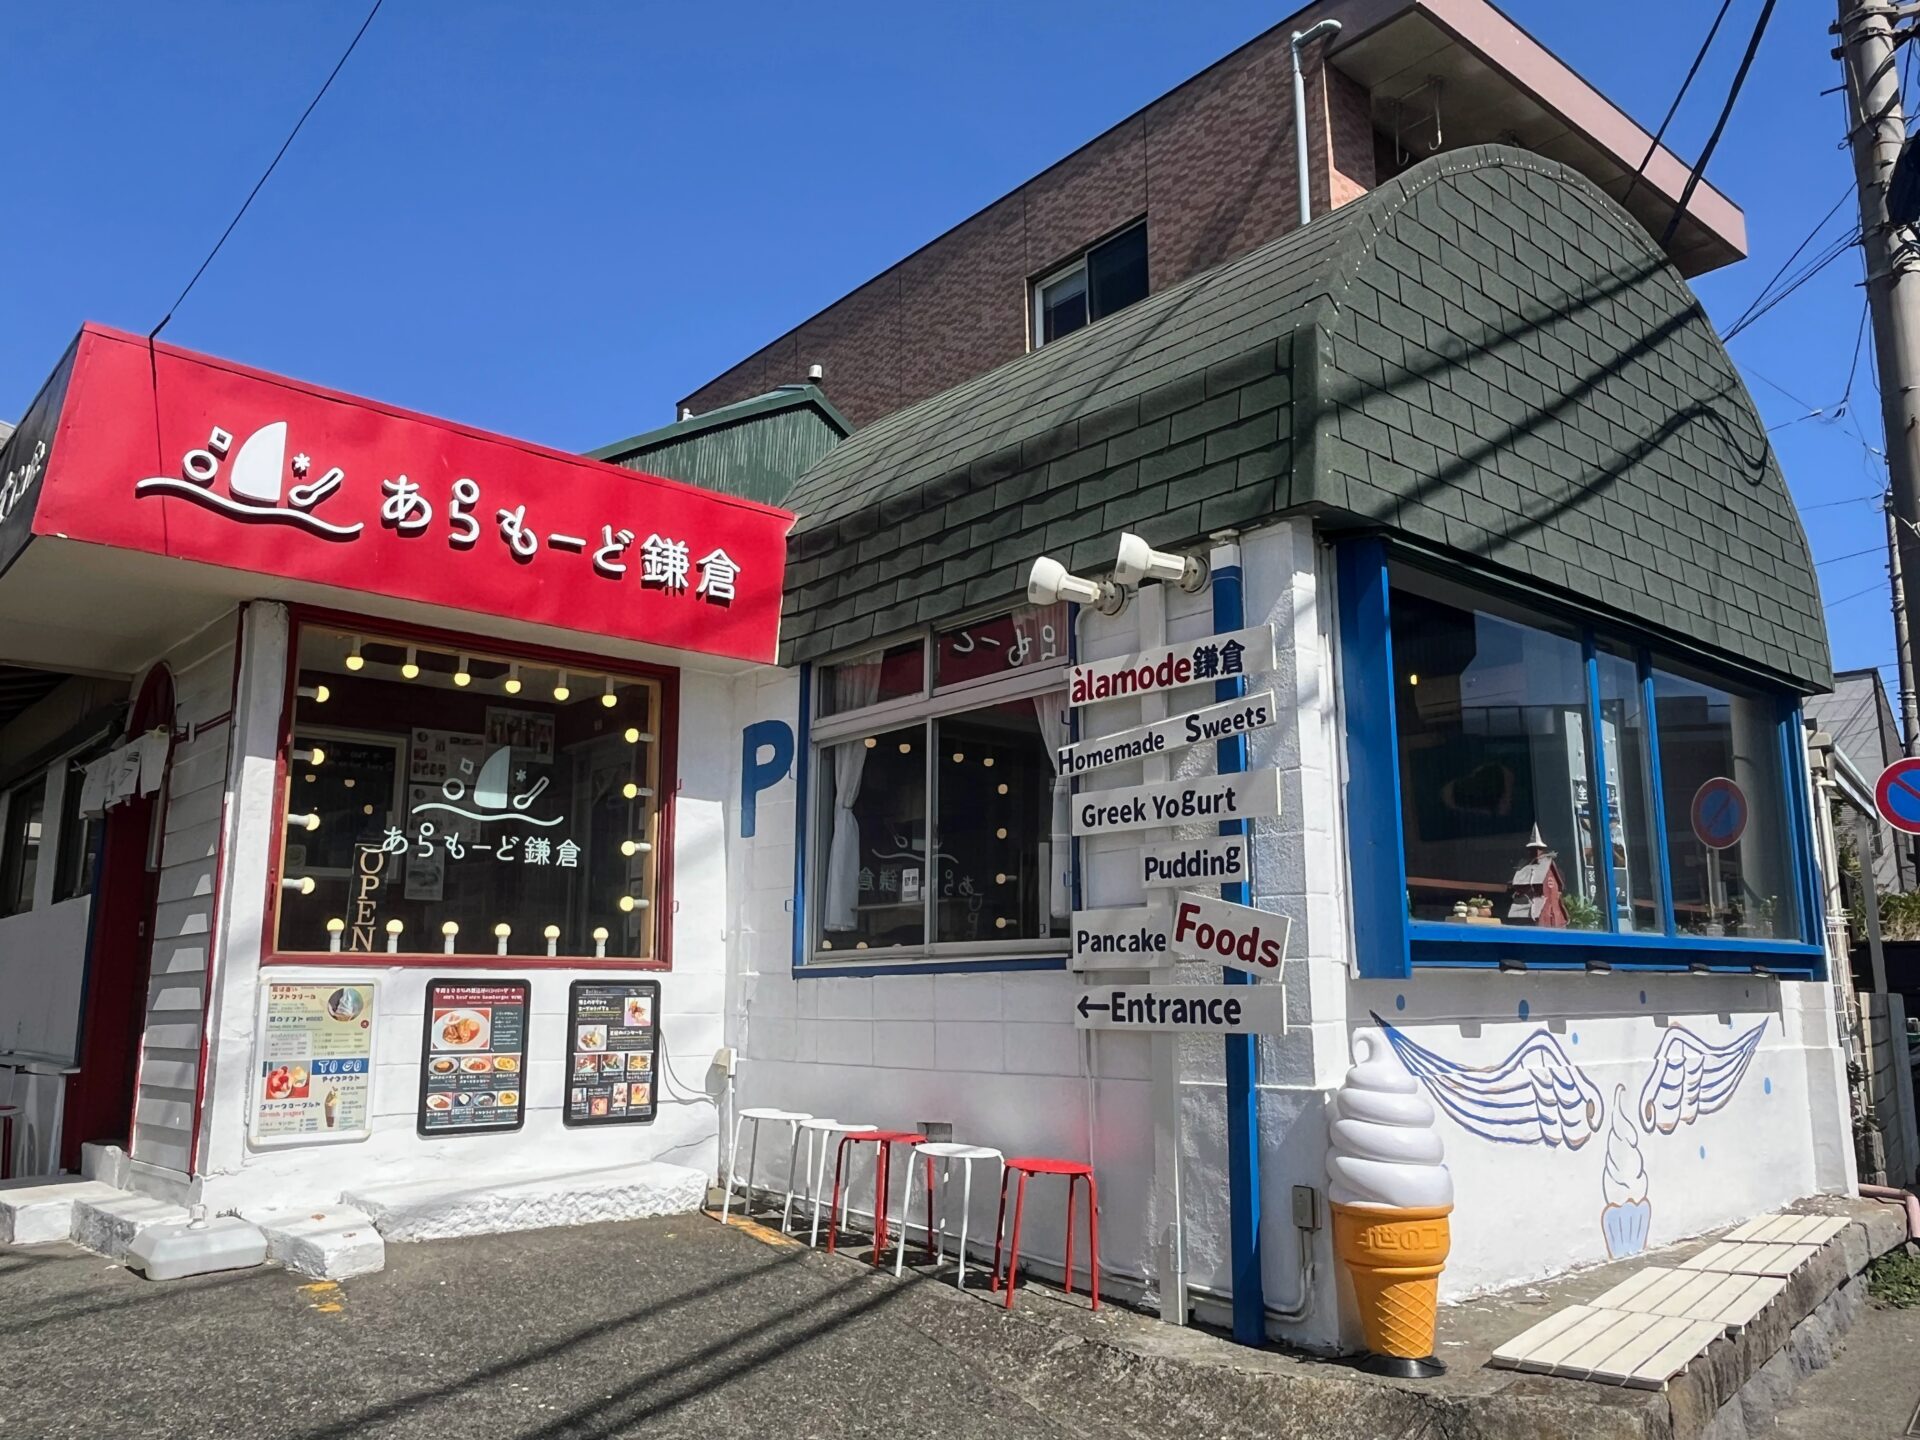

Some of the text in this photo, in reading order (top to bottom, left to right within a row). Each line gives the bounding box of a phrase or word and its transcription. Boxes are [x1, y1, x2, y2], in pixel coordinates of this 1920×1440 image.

[381, 473, 742, 602] あらもーど鎌倉
[1058, 706, 1267, 776] Homemade Sweets
[741, 720, 794, 838] P
[1082, 787, 1237, 828] Greek Yogurt
[382, 822, 581, 868] あらもーど鎌倉
[1144, 846, 1241, 881] Pudding
[349, 847, 384, 952] OPEN
[1077, 928, 1166, 953] Pancake
[1175, 902, 1280, 968] Foods
[1111, 991, 1242, 1025] Entrance
[318, 1060, 362, 1073] TO GO
